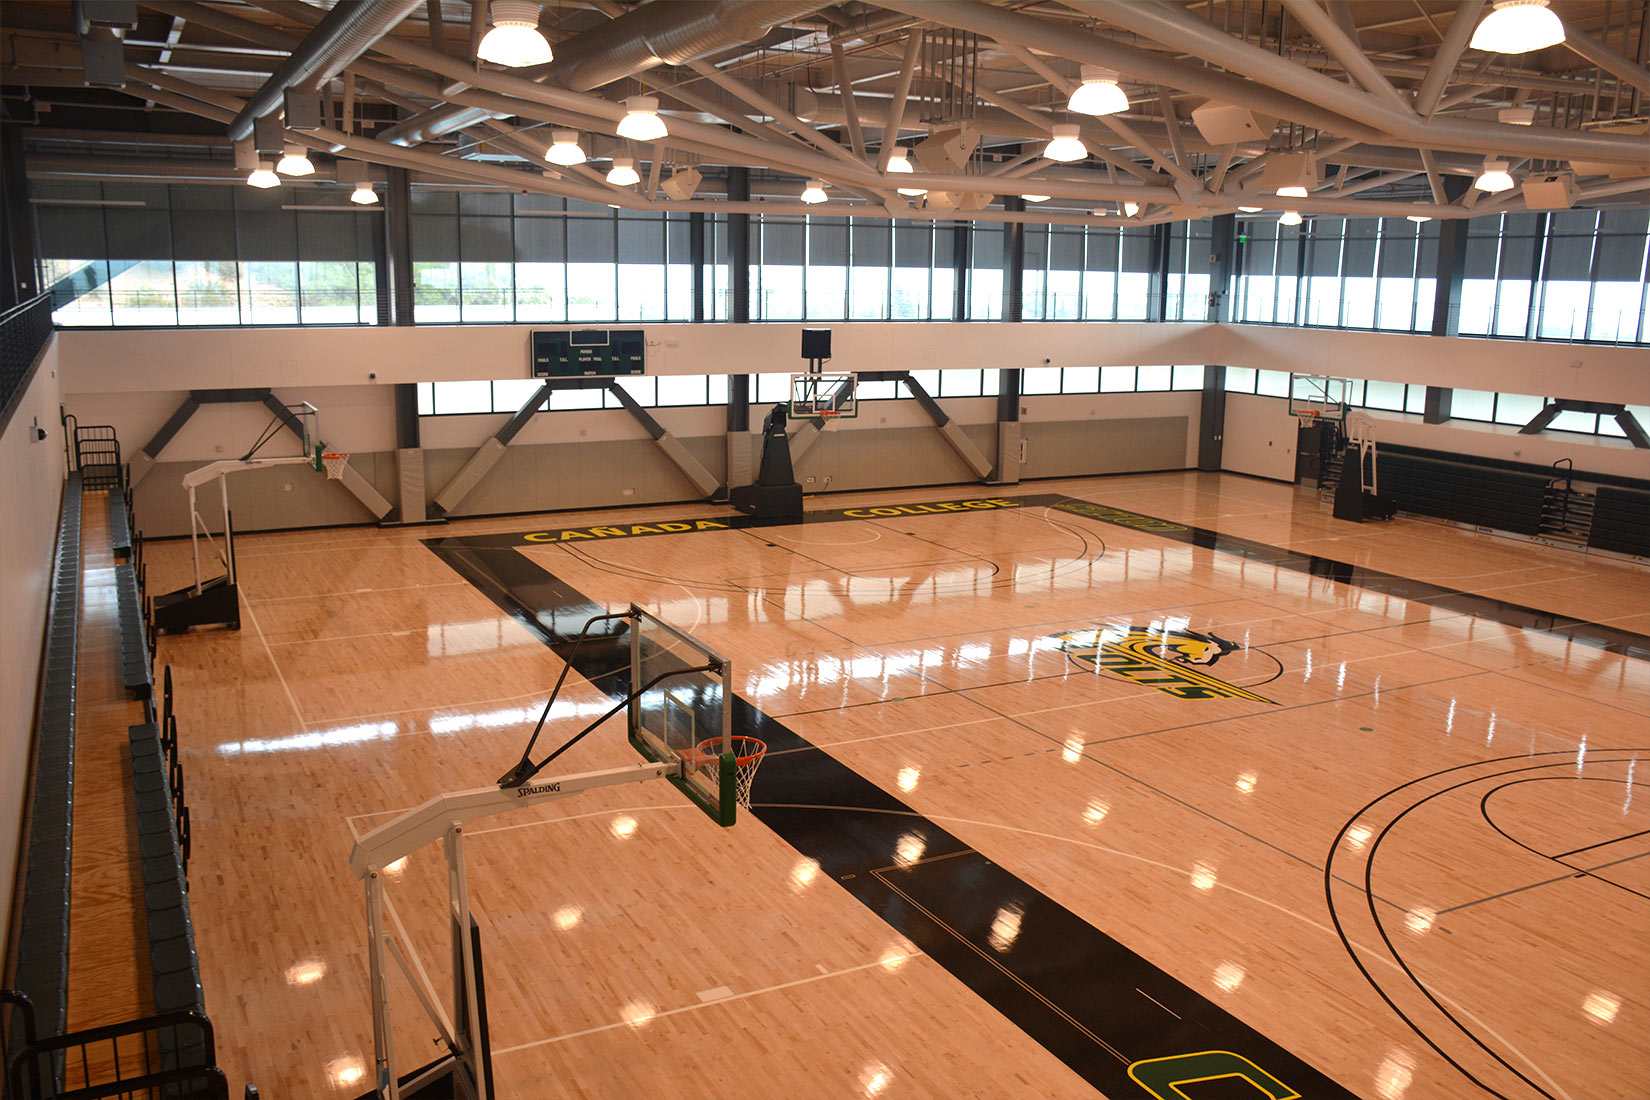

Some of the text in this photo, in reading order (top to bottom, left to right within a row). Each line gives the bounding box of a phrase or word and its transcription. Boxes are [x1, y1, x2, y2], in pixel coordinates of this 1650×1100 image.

[523, 498, 1020, 543] CAÑADA COLLEGE
[517, 782, 561, 798] SPALDING
